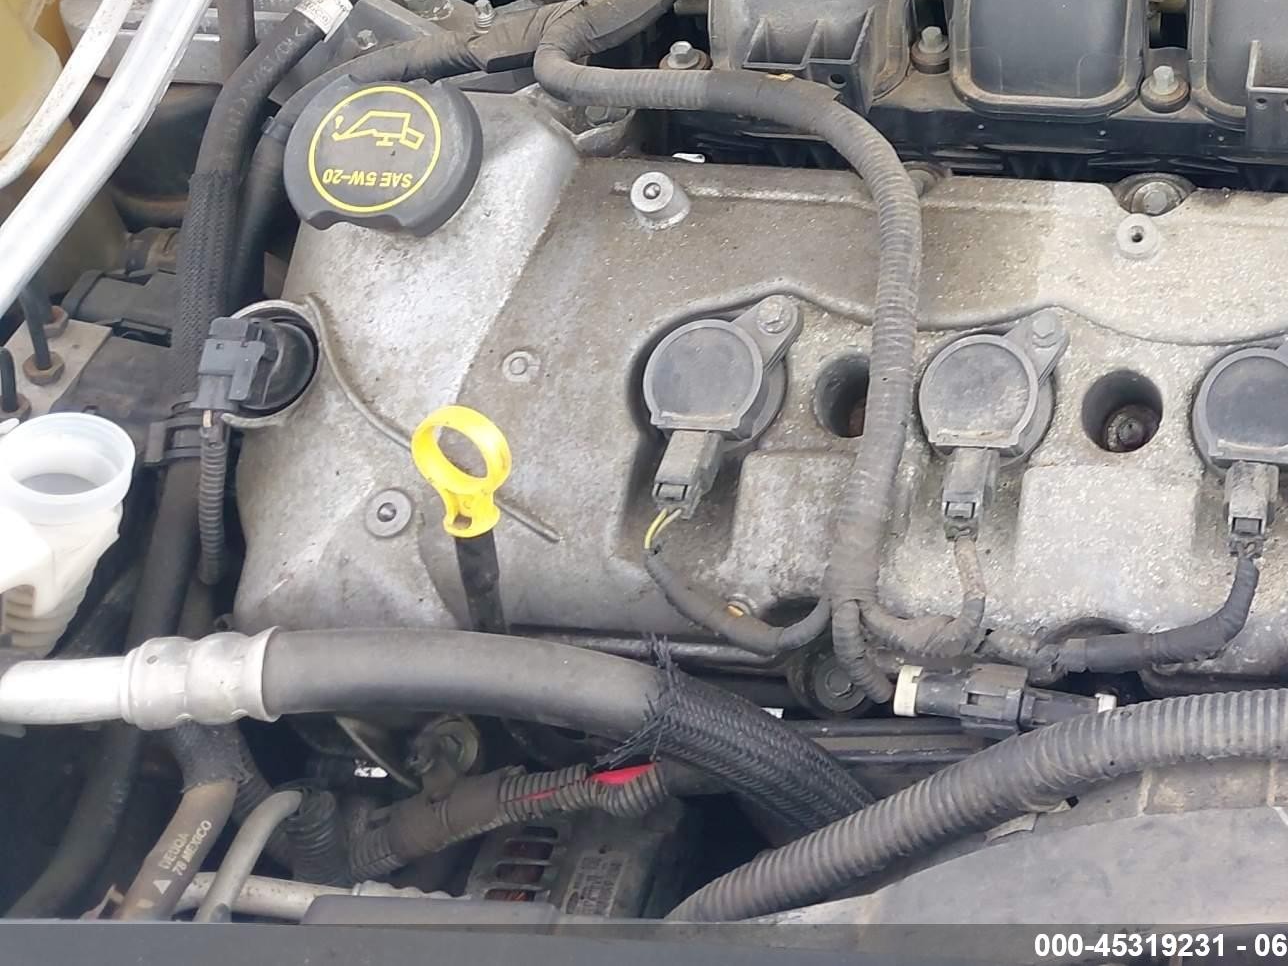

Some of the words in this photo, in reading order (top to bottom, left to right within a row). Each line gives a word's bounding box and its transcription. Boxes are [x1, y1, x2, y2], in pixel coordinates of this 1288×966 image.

[322, 168, 378, 188] 5W-20
[380, 170, 414, 189] SAE
[182, 819, 213, 863] MEXICO
